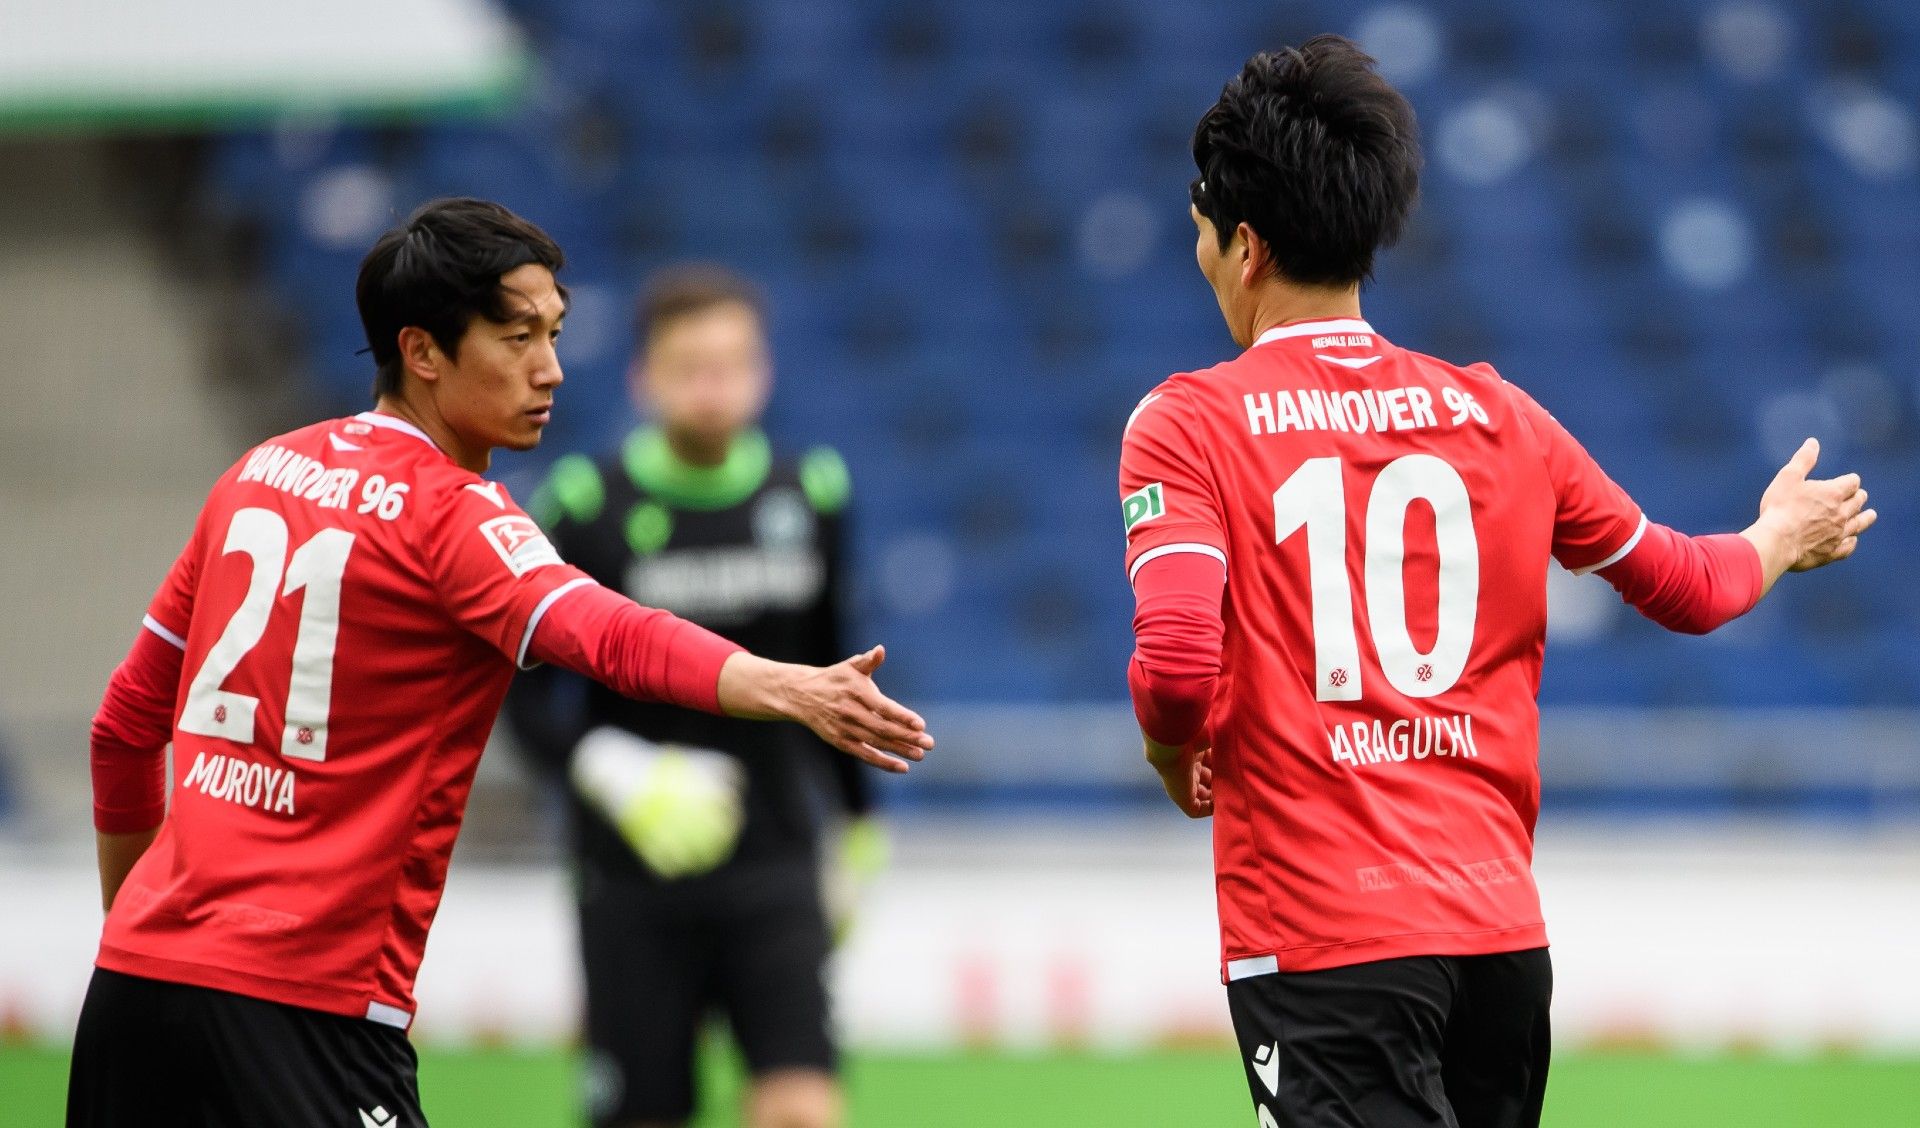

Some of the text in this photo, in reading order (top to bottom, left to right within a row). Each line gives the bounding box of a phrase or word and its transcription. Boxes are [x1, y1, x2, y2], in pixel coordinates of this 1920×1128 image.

[1243, 386, 1489, 435] HANNOVER 96
[237, 445, 410, 521] HANNOVER 96
[1273, 453, 1480, 702] 10
[178, 507, 356, 762] 21
[1330, 669, 1347, 686] 96
[1417, 664, 1432, 681] 96
[183, 751, 295, 816] MUROYA
